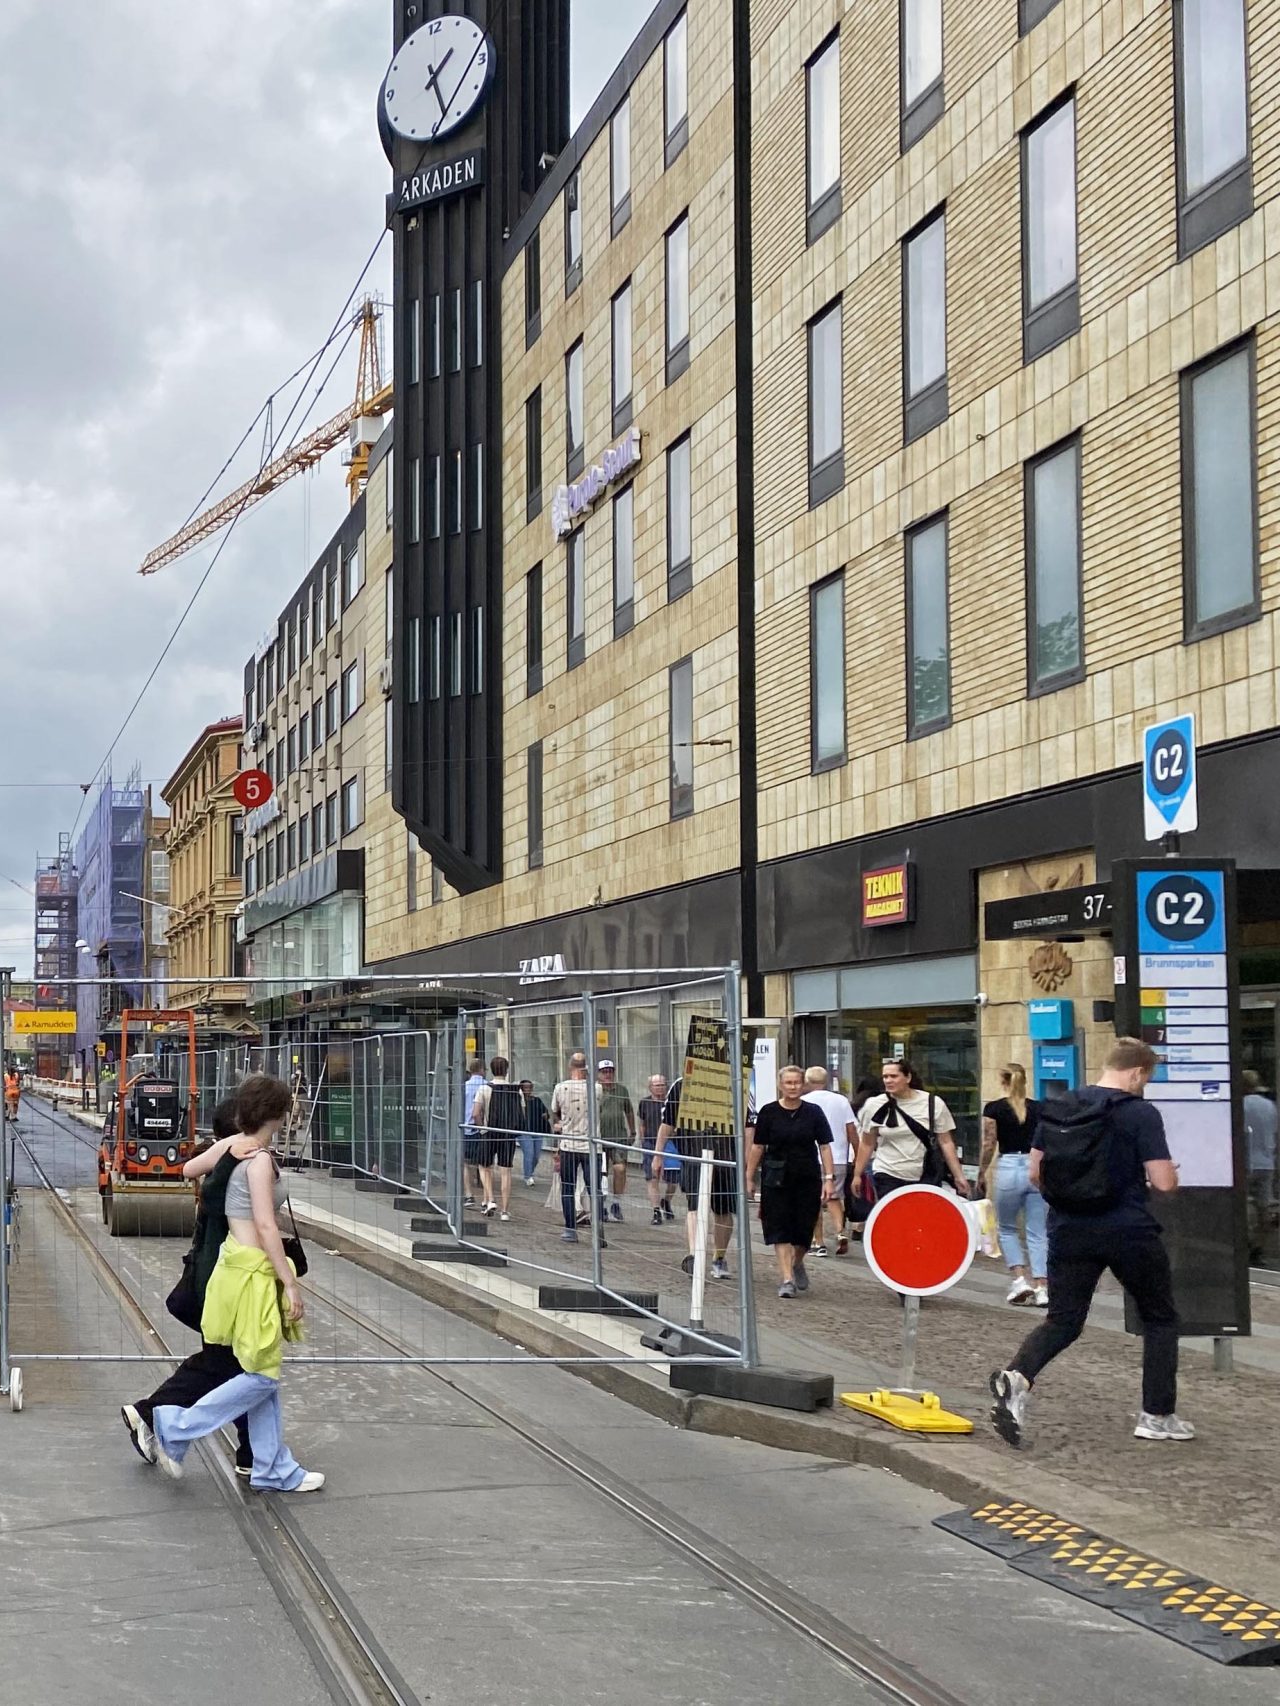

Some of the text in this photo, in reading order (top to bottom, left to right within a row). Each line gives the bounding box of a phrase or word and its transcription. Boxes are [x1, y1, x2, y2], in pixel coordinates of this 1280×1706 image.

[428, 21, 442, 35] 12
[478, 53, 487, 65] 3
[386, 89, 395, 101] 9
[401, 156, 475, 203] ARKADEN
[1155, 744, 1183, 780] C2
[246, 778, 261, 800] 5
[865, 871, 904, 899] TEKNIK
[1156, 891, 1205, 925] C2
[520, 953, 567, 985] ZARA
[1145, 957, 1214, 970] Brunnsparken
[1156, 1011, 1163, 1022] 4
[31, 1020, 74, 1029] Ramudden
[1157, 1030, 1164, 1042] 7
[756, 1044, 770, 1054] LEN
